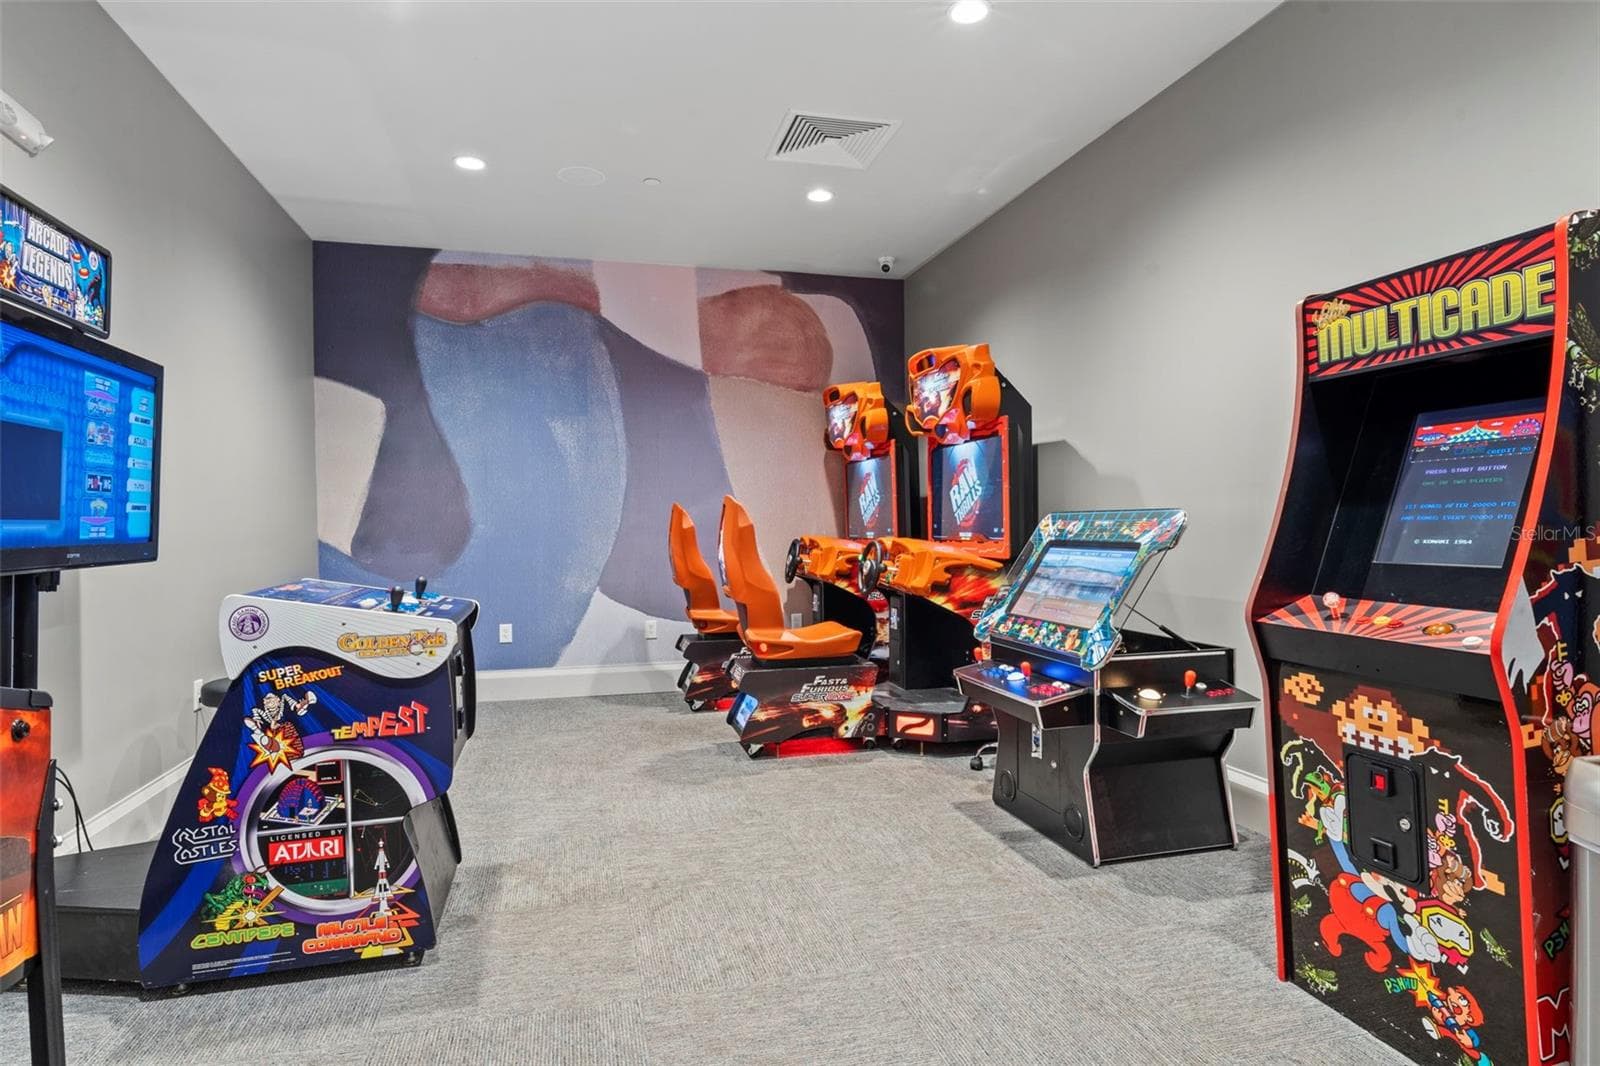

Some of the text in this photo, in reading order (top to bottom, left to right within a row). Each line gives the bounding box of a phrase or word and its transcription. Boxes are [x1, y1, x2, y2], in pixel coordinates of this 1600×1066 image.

[27, 216, 70, 259] ARCADE
[22, 240, 74, 290] LEGENDS
[1317, 260, 1555, 365] MULTICADE
[1451, 466, 1474, 474] START
[1477, 464, 1508, 472] BUTTON
[949, 457, 978, 513] RAW
[258, 664, 303, 682] SUPER
[275, 665, 343, 690] BREAKOUT
[800, 683, 849, 693] FURIOUS
[331, 700, 429, 741] TEMPEST
[269, 828, 344, 842] LICENSED BY
[273, 839, 341, 862] ATARI
[190, 922, 296, 949] CENTIPEDE
